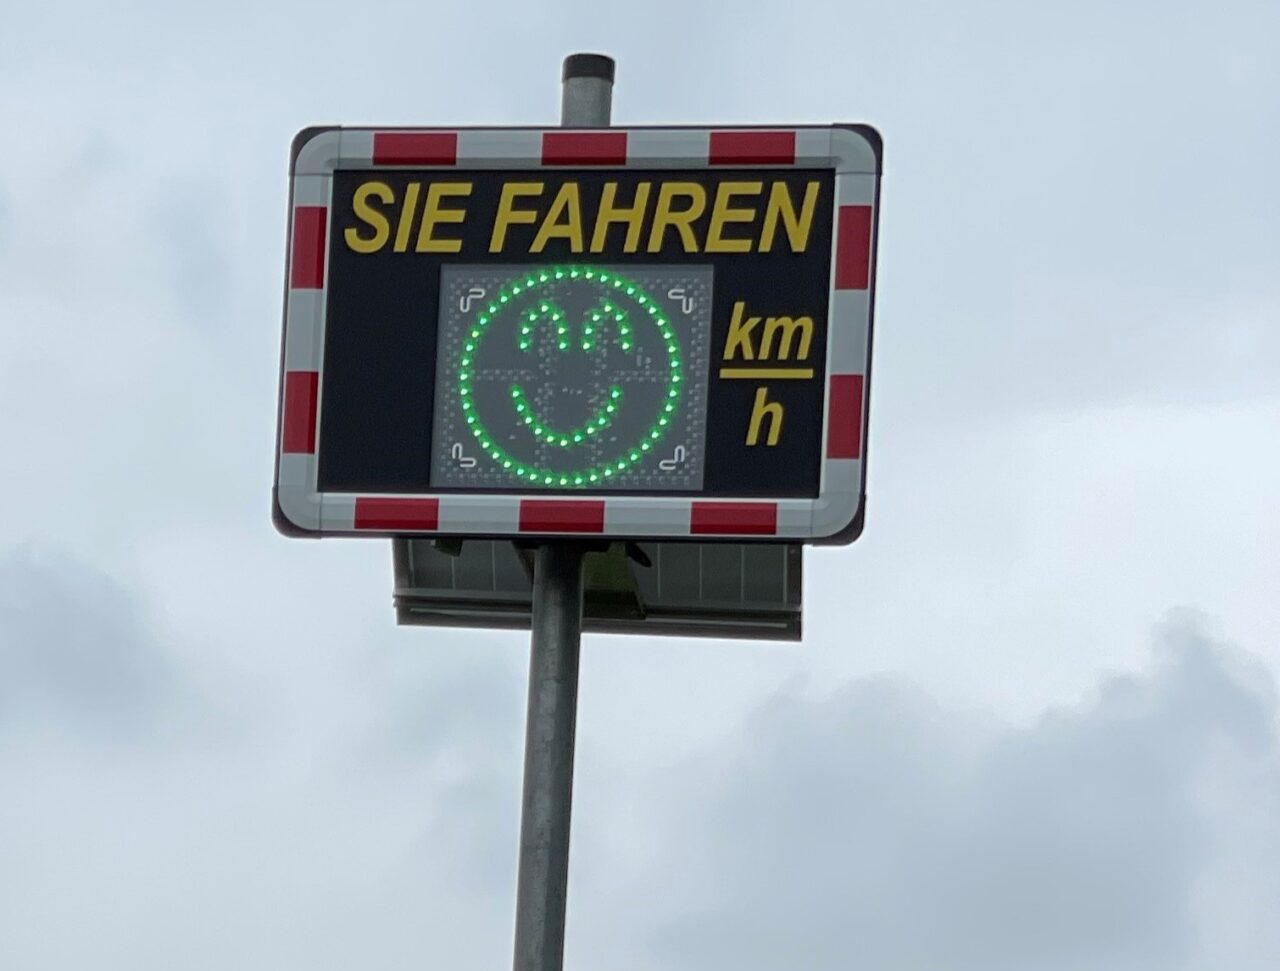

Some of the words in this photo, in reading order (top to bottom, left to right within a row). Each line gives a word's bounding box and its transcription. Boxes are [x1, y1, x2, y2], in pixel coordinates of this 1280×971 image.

[344, 181, 473, 254] SIE
[487, 181, 820, 254] FAHREN
[722, 301, 814, 362] km
[745, 387, 784, 447] h
